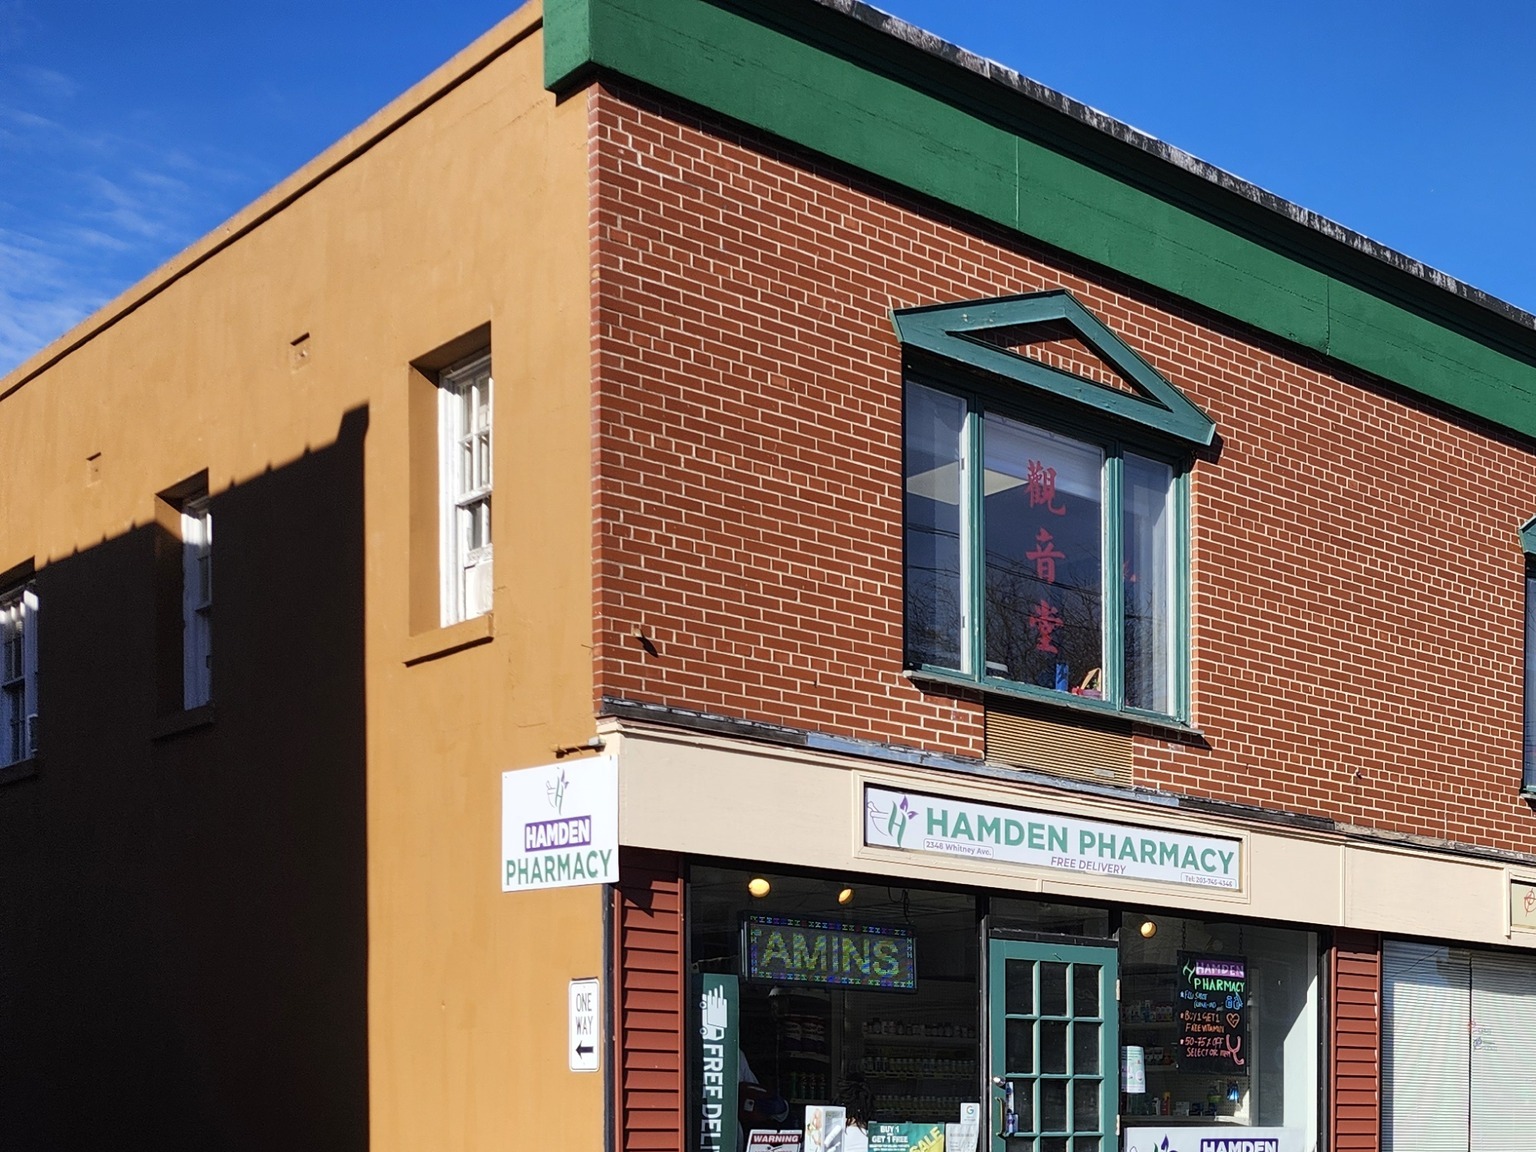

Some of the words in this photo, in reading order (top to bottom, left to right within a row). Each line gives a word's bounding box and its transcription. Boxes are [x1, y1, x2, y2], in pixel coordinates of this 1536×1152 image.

[526, 819, 590, 849] HAMDEN
[926, 807, 1069, 854] HAMDEN
[1079, 830, 1235, 875] PHARMACY
[926, 841, 943, 850] 2348
[945, 843, 975, 855] Whitney
[506, 849, 612, 885] PHARMACY
[1050, 856, 1076, 870] FREE
[1079, 859, 1127, 875] DELIVERY
[760, 930, 899, 977] AMINS
[1196, 961, 1244, 977] HAMDEN
[1194, 978, 1245, 992] PHARMACY
[576, 993, 592, 1012] ONE
[575, 1016, 593, 1036] WAY
[702, 1044, 723, 1099] FREE
